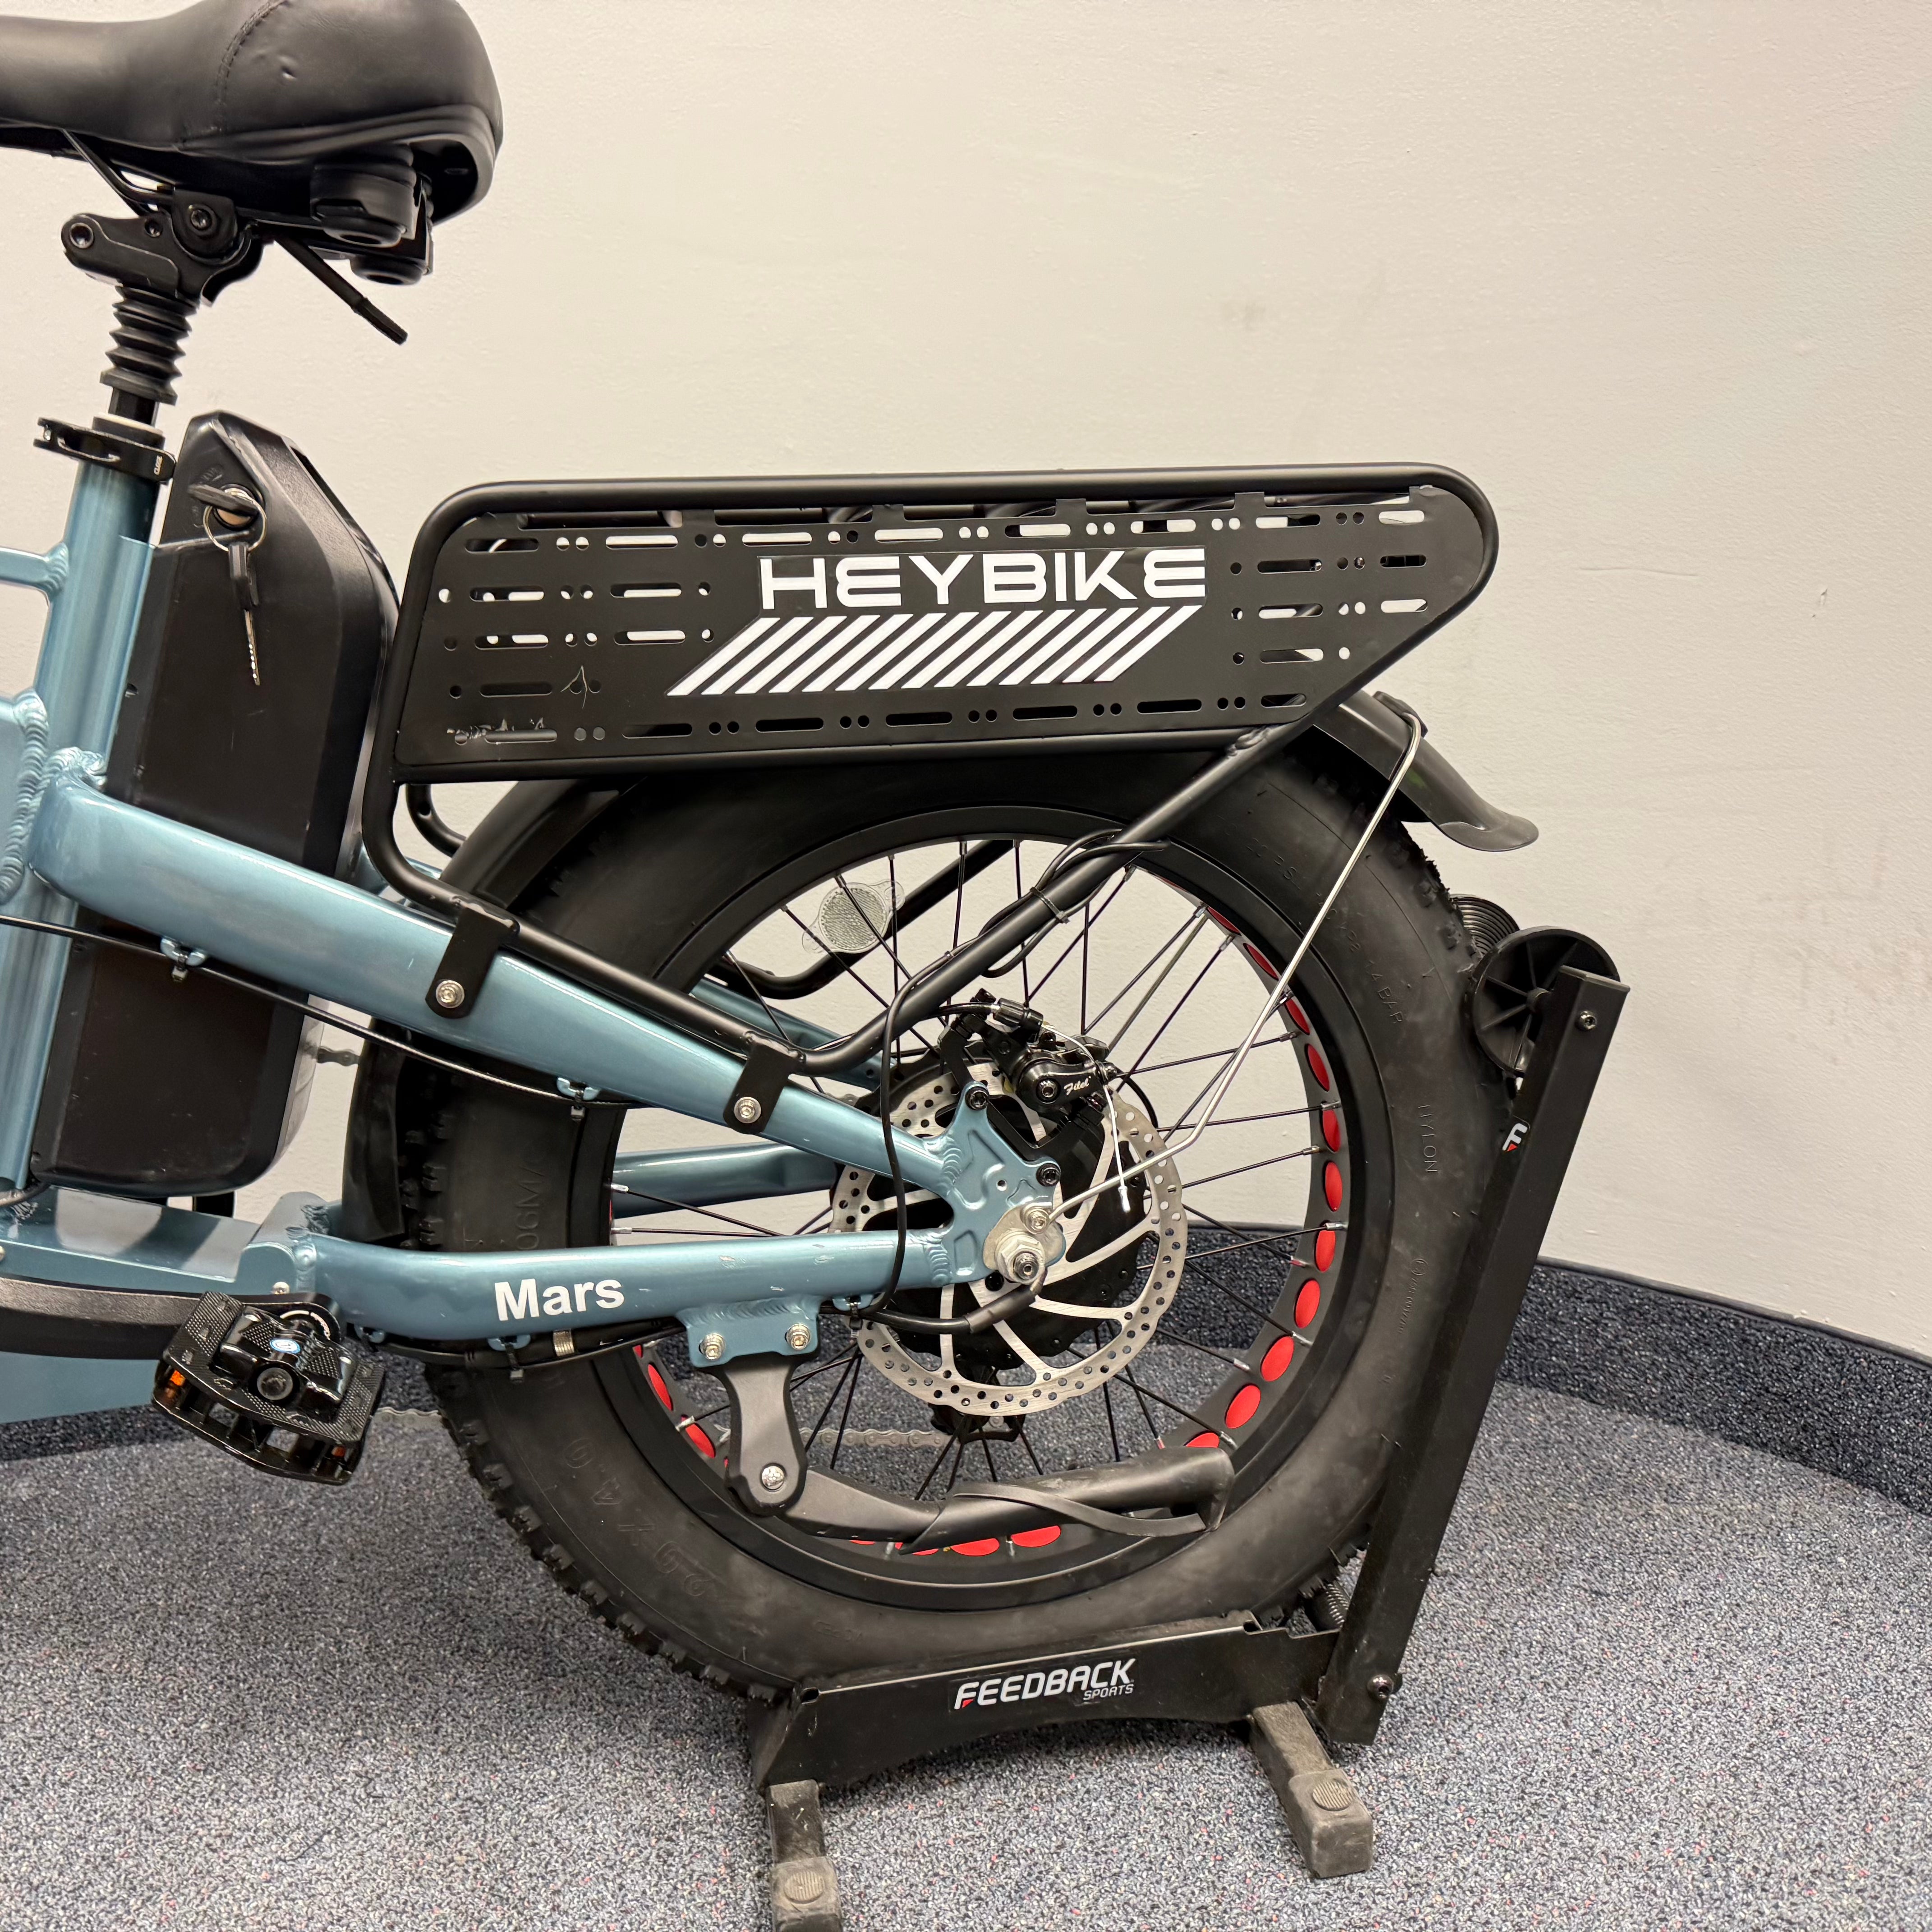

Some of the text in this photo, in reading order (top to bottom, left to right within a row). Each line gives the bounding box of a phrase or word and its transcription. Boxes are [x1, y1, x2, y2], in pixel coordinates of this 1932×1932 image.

[760, 549, 1205, 609] HEYBIKE
[1376, 985, 1404, 1025] BAR
[1417, 1104, 1439, 1173] NYLON
[495, 1279, 624, 1320] Mars
[954, 1658, 1136, 1710] FEEDBACK
[1083, 1684, 1134, 1701] SPORTS
